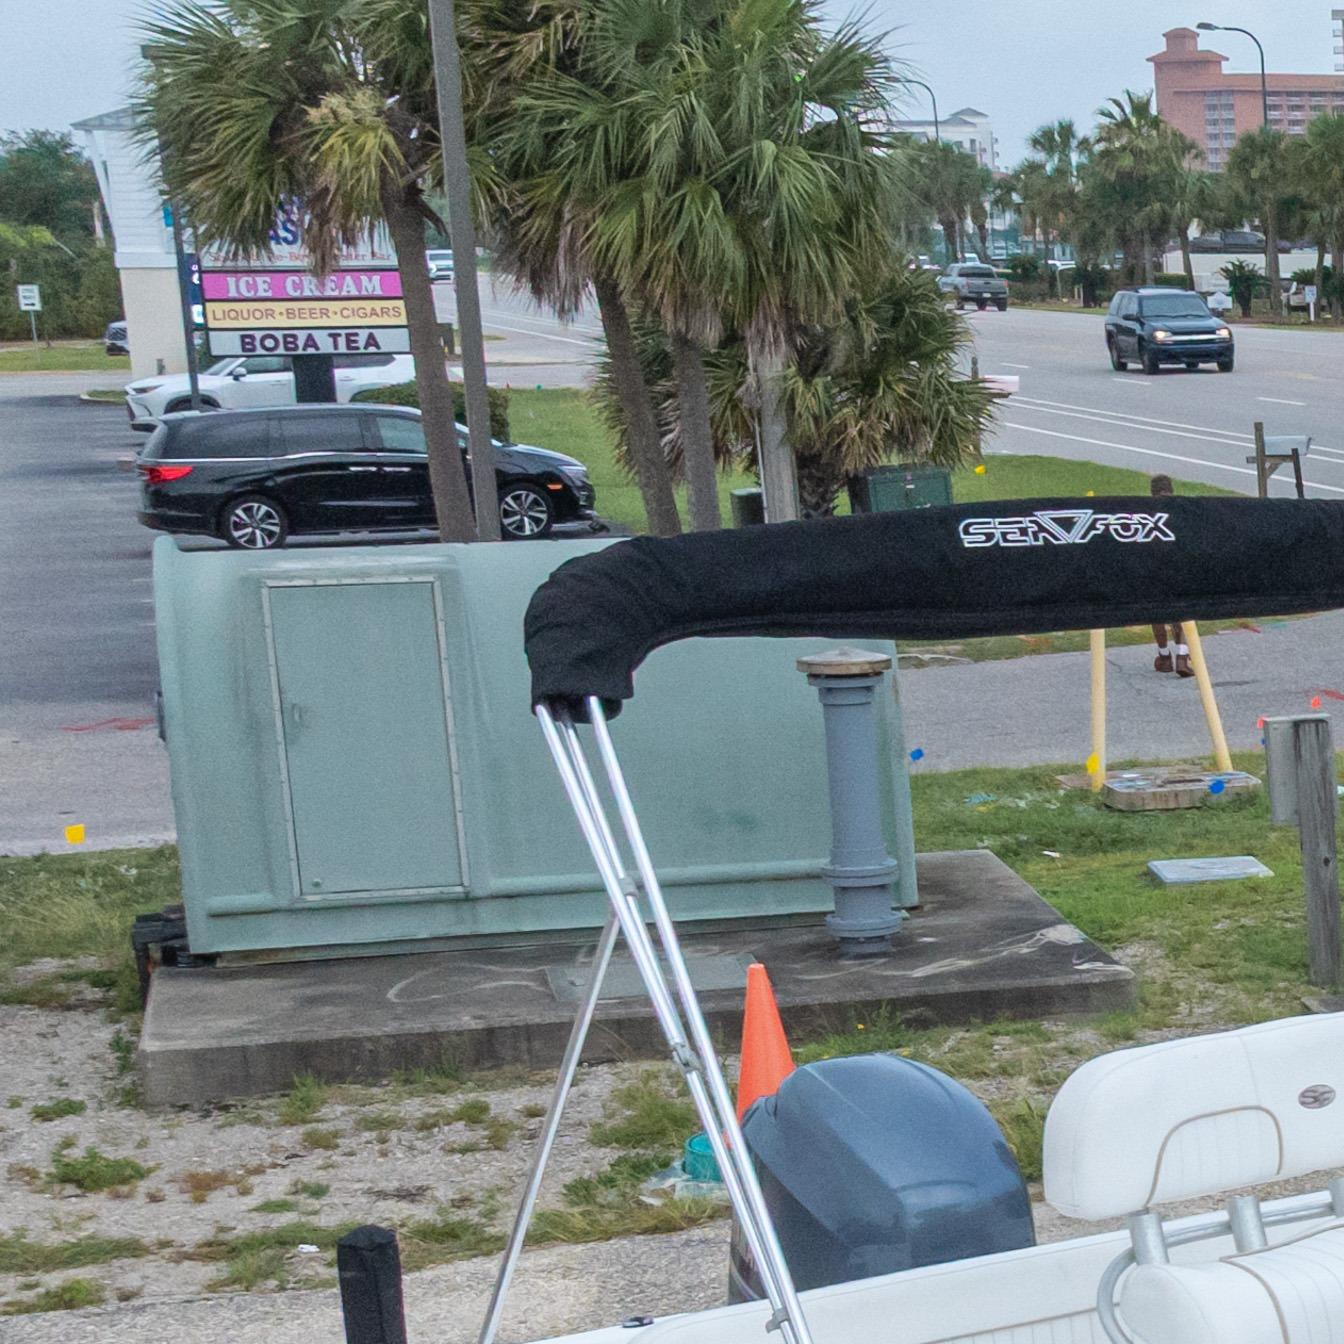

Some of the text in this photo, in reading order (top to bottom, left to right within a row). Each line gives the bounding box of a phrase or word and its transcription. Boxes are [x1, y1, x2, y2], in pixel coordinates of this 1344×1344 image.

[226, 275, 384, 297] ICE CREAM
[212, 306, 402, 321] LIQUOR BEER CIGARS
[240, 332, 382, 353] BOBA TEA
